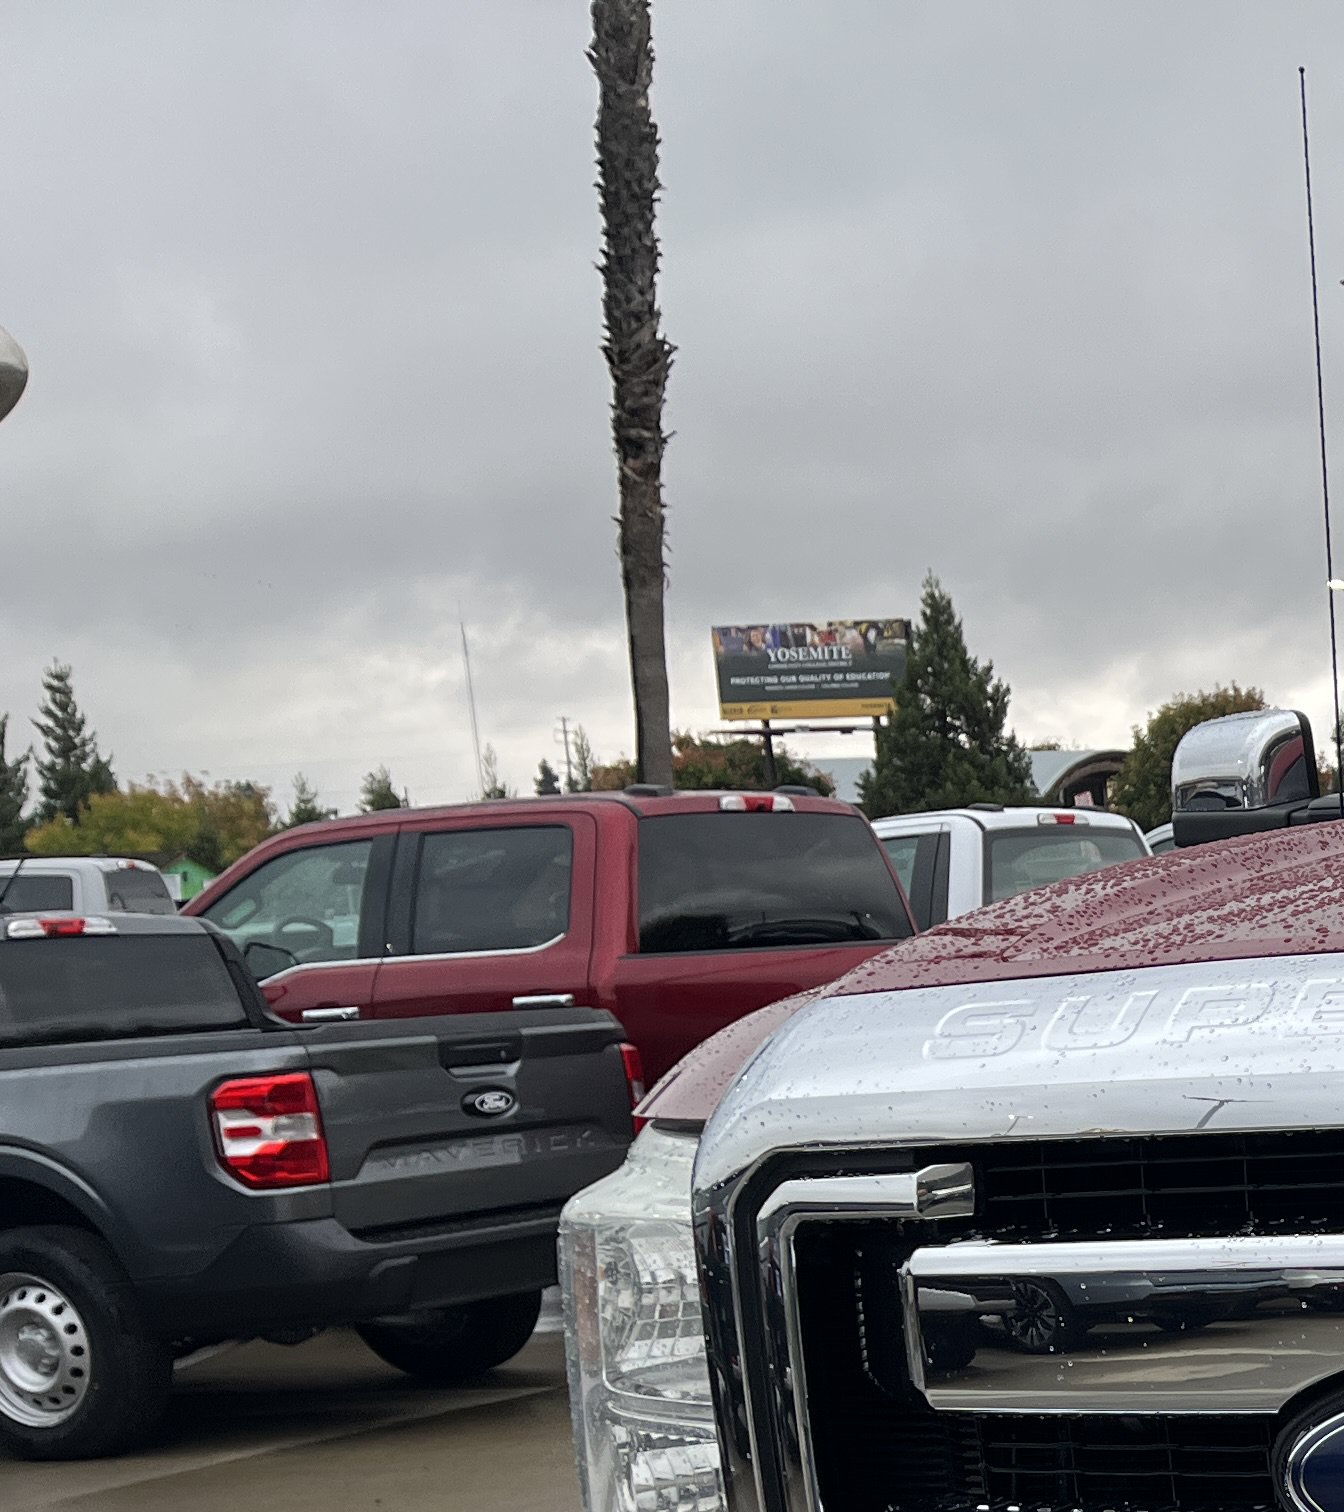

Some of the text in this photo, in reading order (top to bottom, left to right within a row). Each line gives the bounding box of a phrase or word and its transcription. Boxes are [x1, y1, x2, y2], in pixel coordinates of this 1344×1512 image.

[766, 645, 852, 662] YOSEMITE
[730, 671, 890, 685] PROTECTING OUR QUALITY OF EDUCATION
